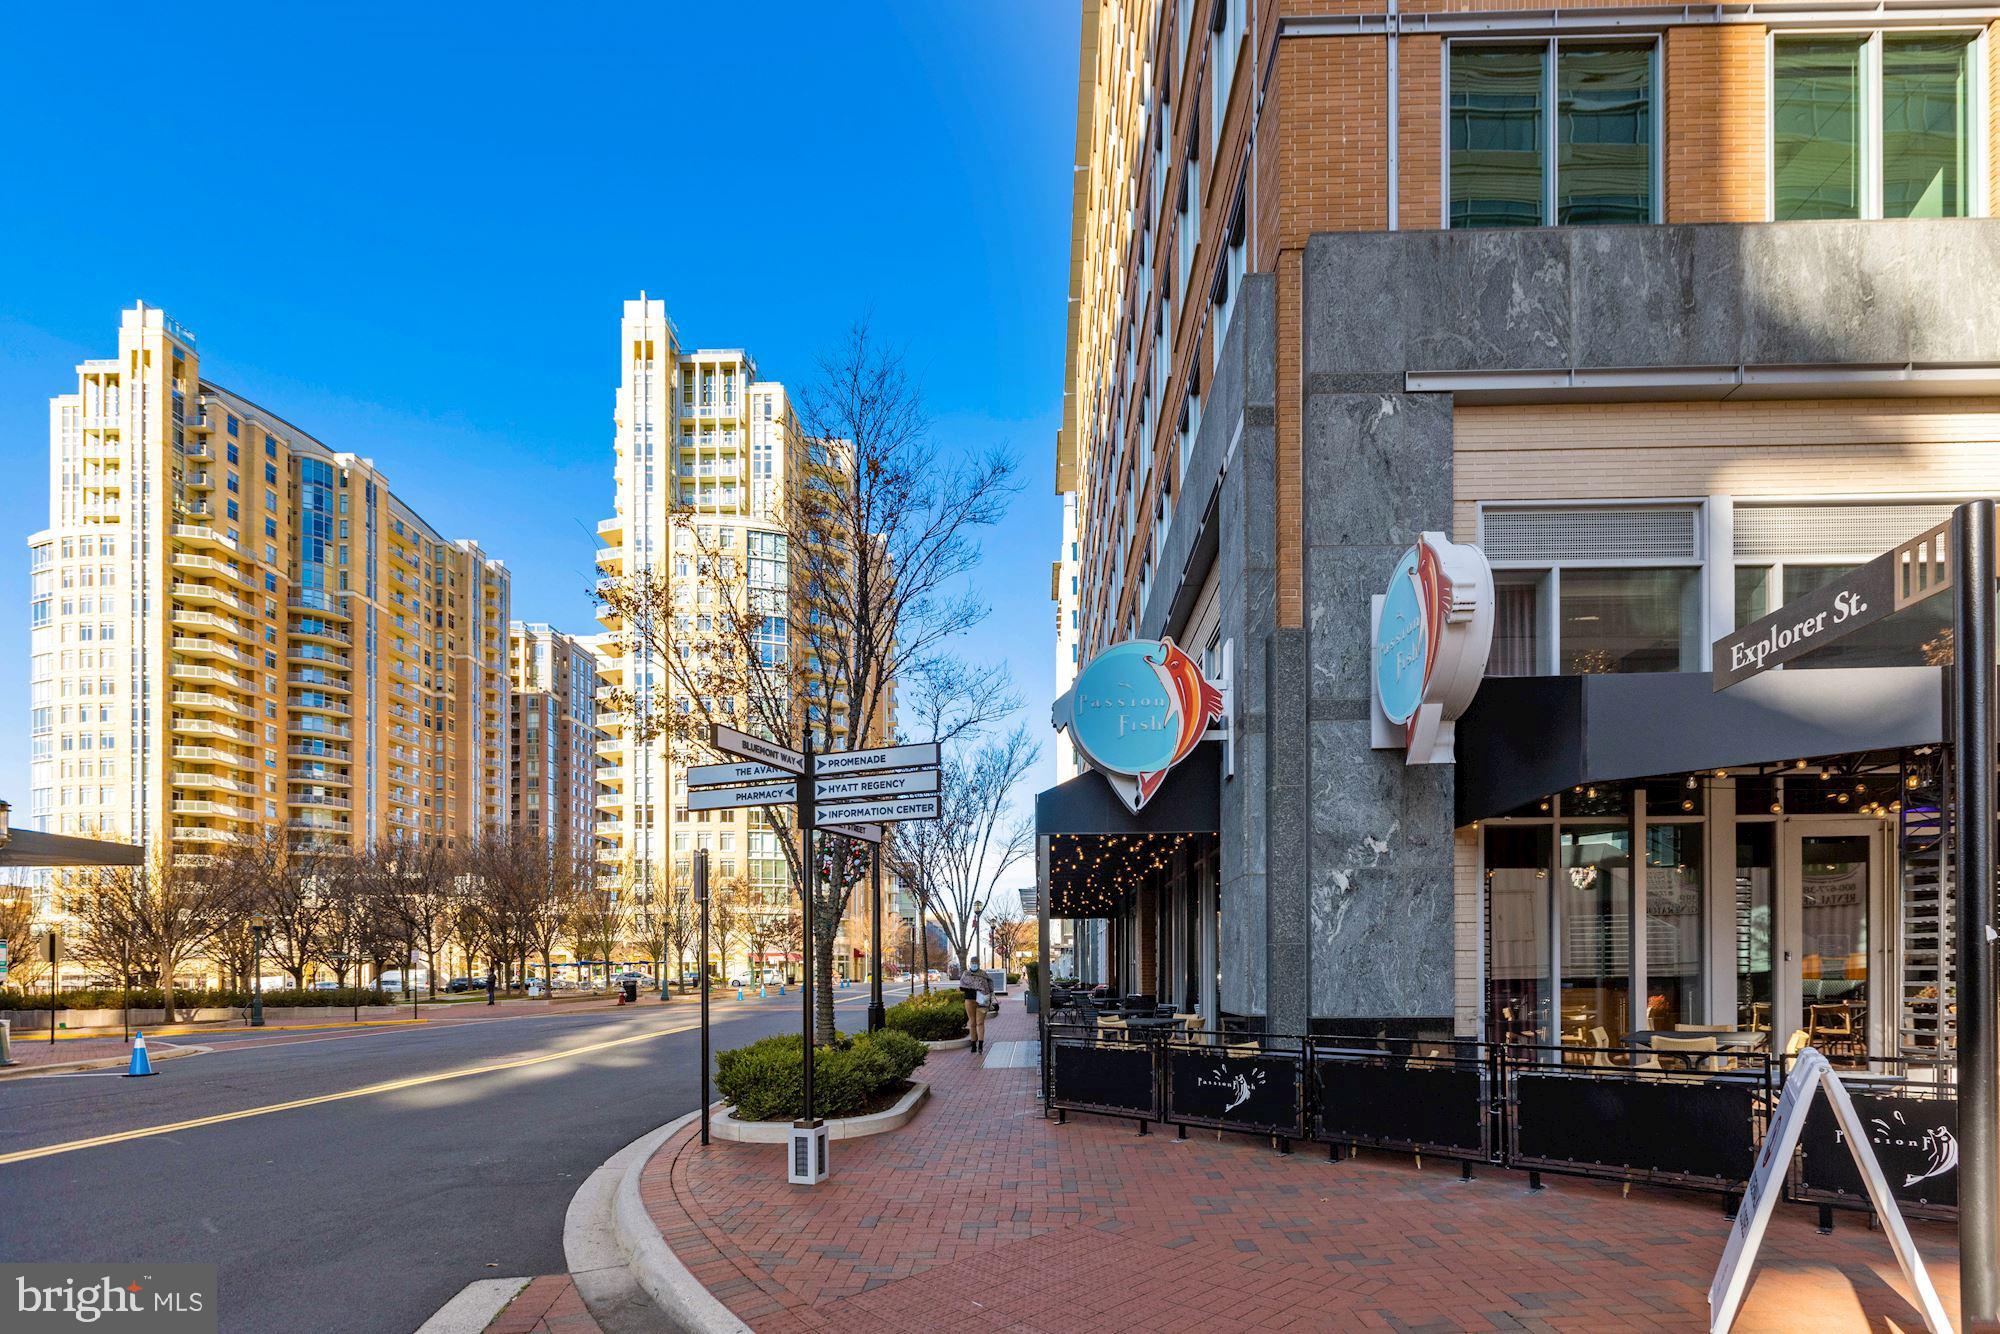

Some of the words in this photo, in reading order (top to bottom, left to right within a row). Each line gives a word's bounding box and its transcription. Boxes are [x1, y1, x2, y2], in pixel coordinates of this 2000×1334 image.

[1730, 609, 1827, 672] Explorer
[1833, 590, 1868, 625] St.
[1078, 694, 1166, 715] Passion
[1117, 713, 1164, 738] Fish
[742, 740, 779, 760] BLUEMONT
[780, 752, 796, 765] WAY
[828, 754, 886, 768] PROMENADE
[735, 766, 752, 776] THE
[753, 765, 784, 775] AVAN
[828, 783, 858, 793] HYATT
[861, 779, 906, 791] REGENCY
[735, 789, 783, 801] PHARMACY
[828, 806, 894, 819] INFORMATION
[896, 803, 934, 814] CENTER
